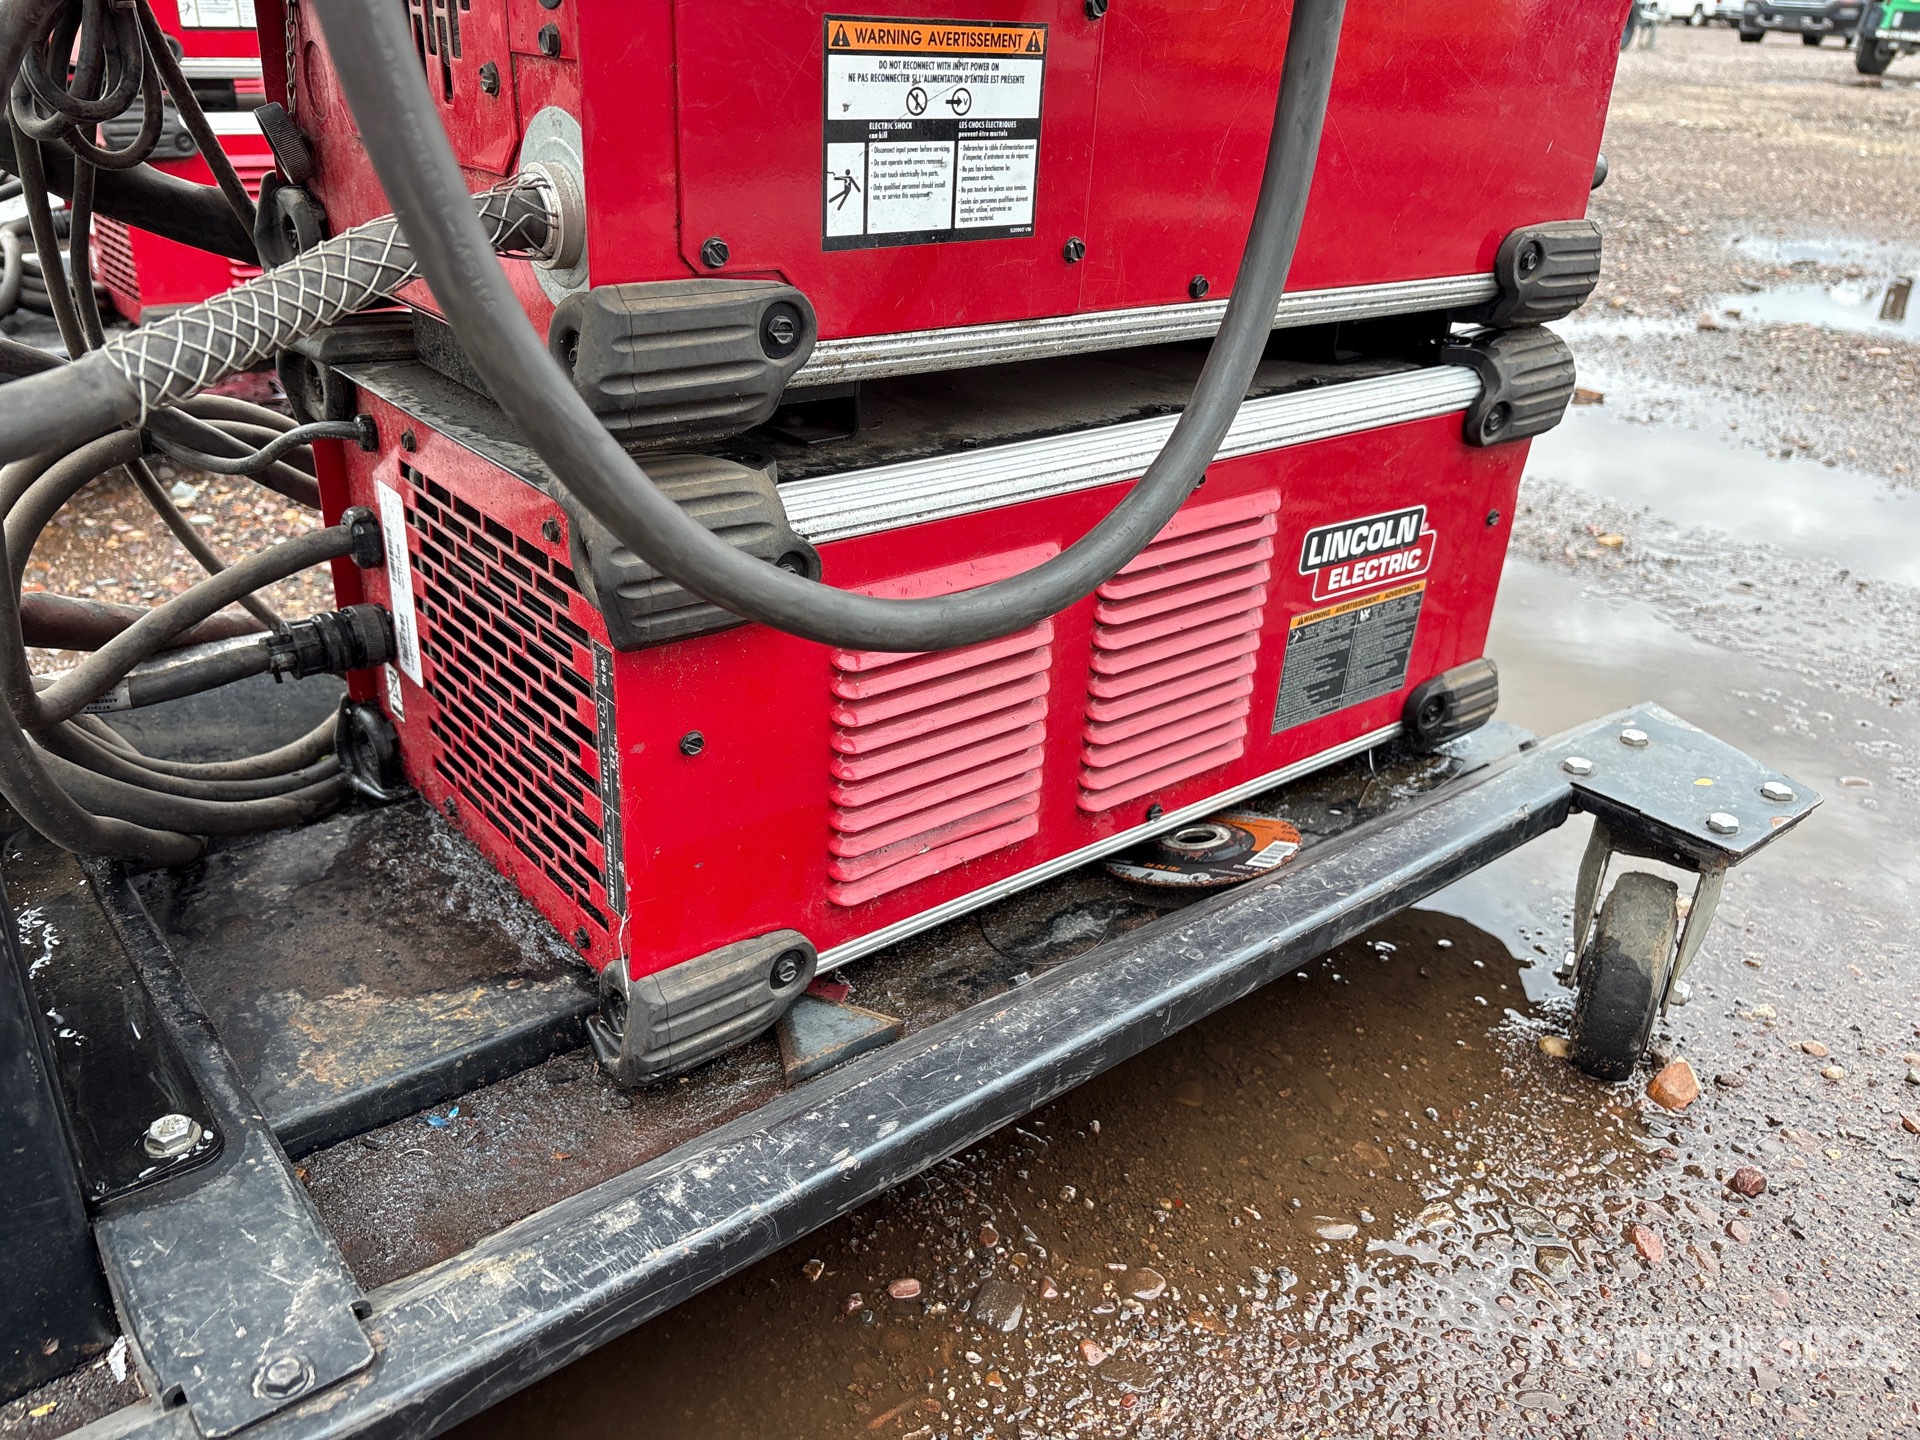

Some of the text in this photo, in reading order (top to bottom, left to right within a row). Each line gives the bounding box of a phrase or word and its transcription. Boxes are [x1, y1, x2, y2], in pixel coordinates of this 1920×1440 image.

[855, 28, 1023, 49] WARNING AVERTISSEMENT
[879, 60, 999, 72] DO NOT RECONNECT WITH INPUT POWER ON
[848, 73, 857, 82] NE
[858, 73, 868, 82] PAS
[870, 73, 910, 83] RECONNECTER
[990, 75, 999, 84] EST
[1000, 75, 1025, 84] PRÉSENTE
[869, 122, 912, 130] ELECTRIC SHOCK
[959, 120, 1016, 128] LES CHOCS ÉLECTRIQUES
[958, 131, 978, 139] peuvent
[874, 146, 895, 154] Disconnect
[896, 146, 906, 154] input
[920, 145, 932, 153] before
[874, 158, 879, 166] Do
[888, 159, 903, 167] operate
[888, 170, 898, 178] touch
[900, 170, 919, 178] electrically
[873, 183, 882, 192] Only
[884, 182, 900, 191] qualified
[902, 182, 920, 190] personnel
[921, 180, 934, 189] should
[888, 192, 900, 200] service
[1307, 514, 1419, 566] LINCOLN
[1328, 548, 1422, 591] ELECTRIC
[1303, 609, 1330, 624] WARNING
[1335, 595, 1380, 614] AVERTISSEMENT
[1384, 584, 1420, 599] ADVERTENCIA
